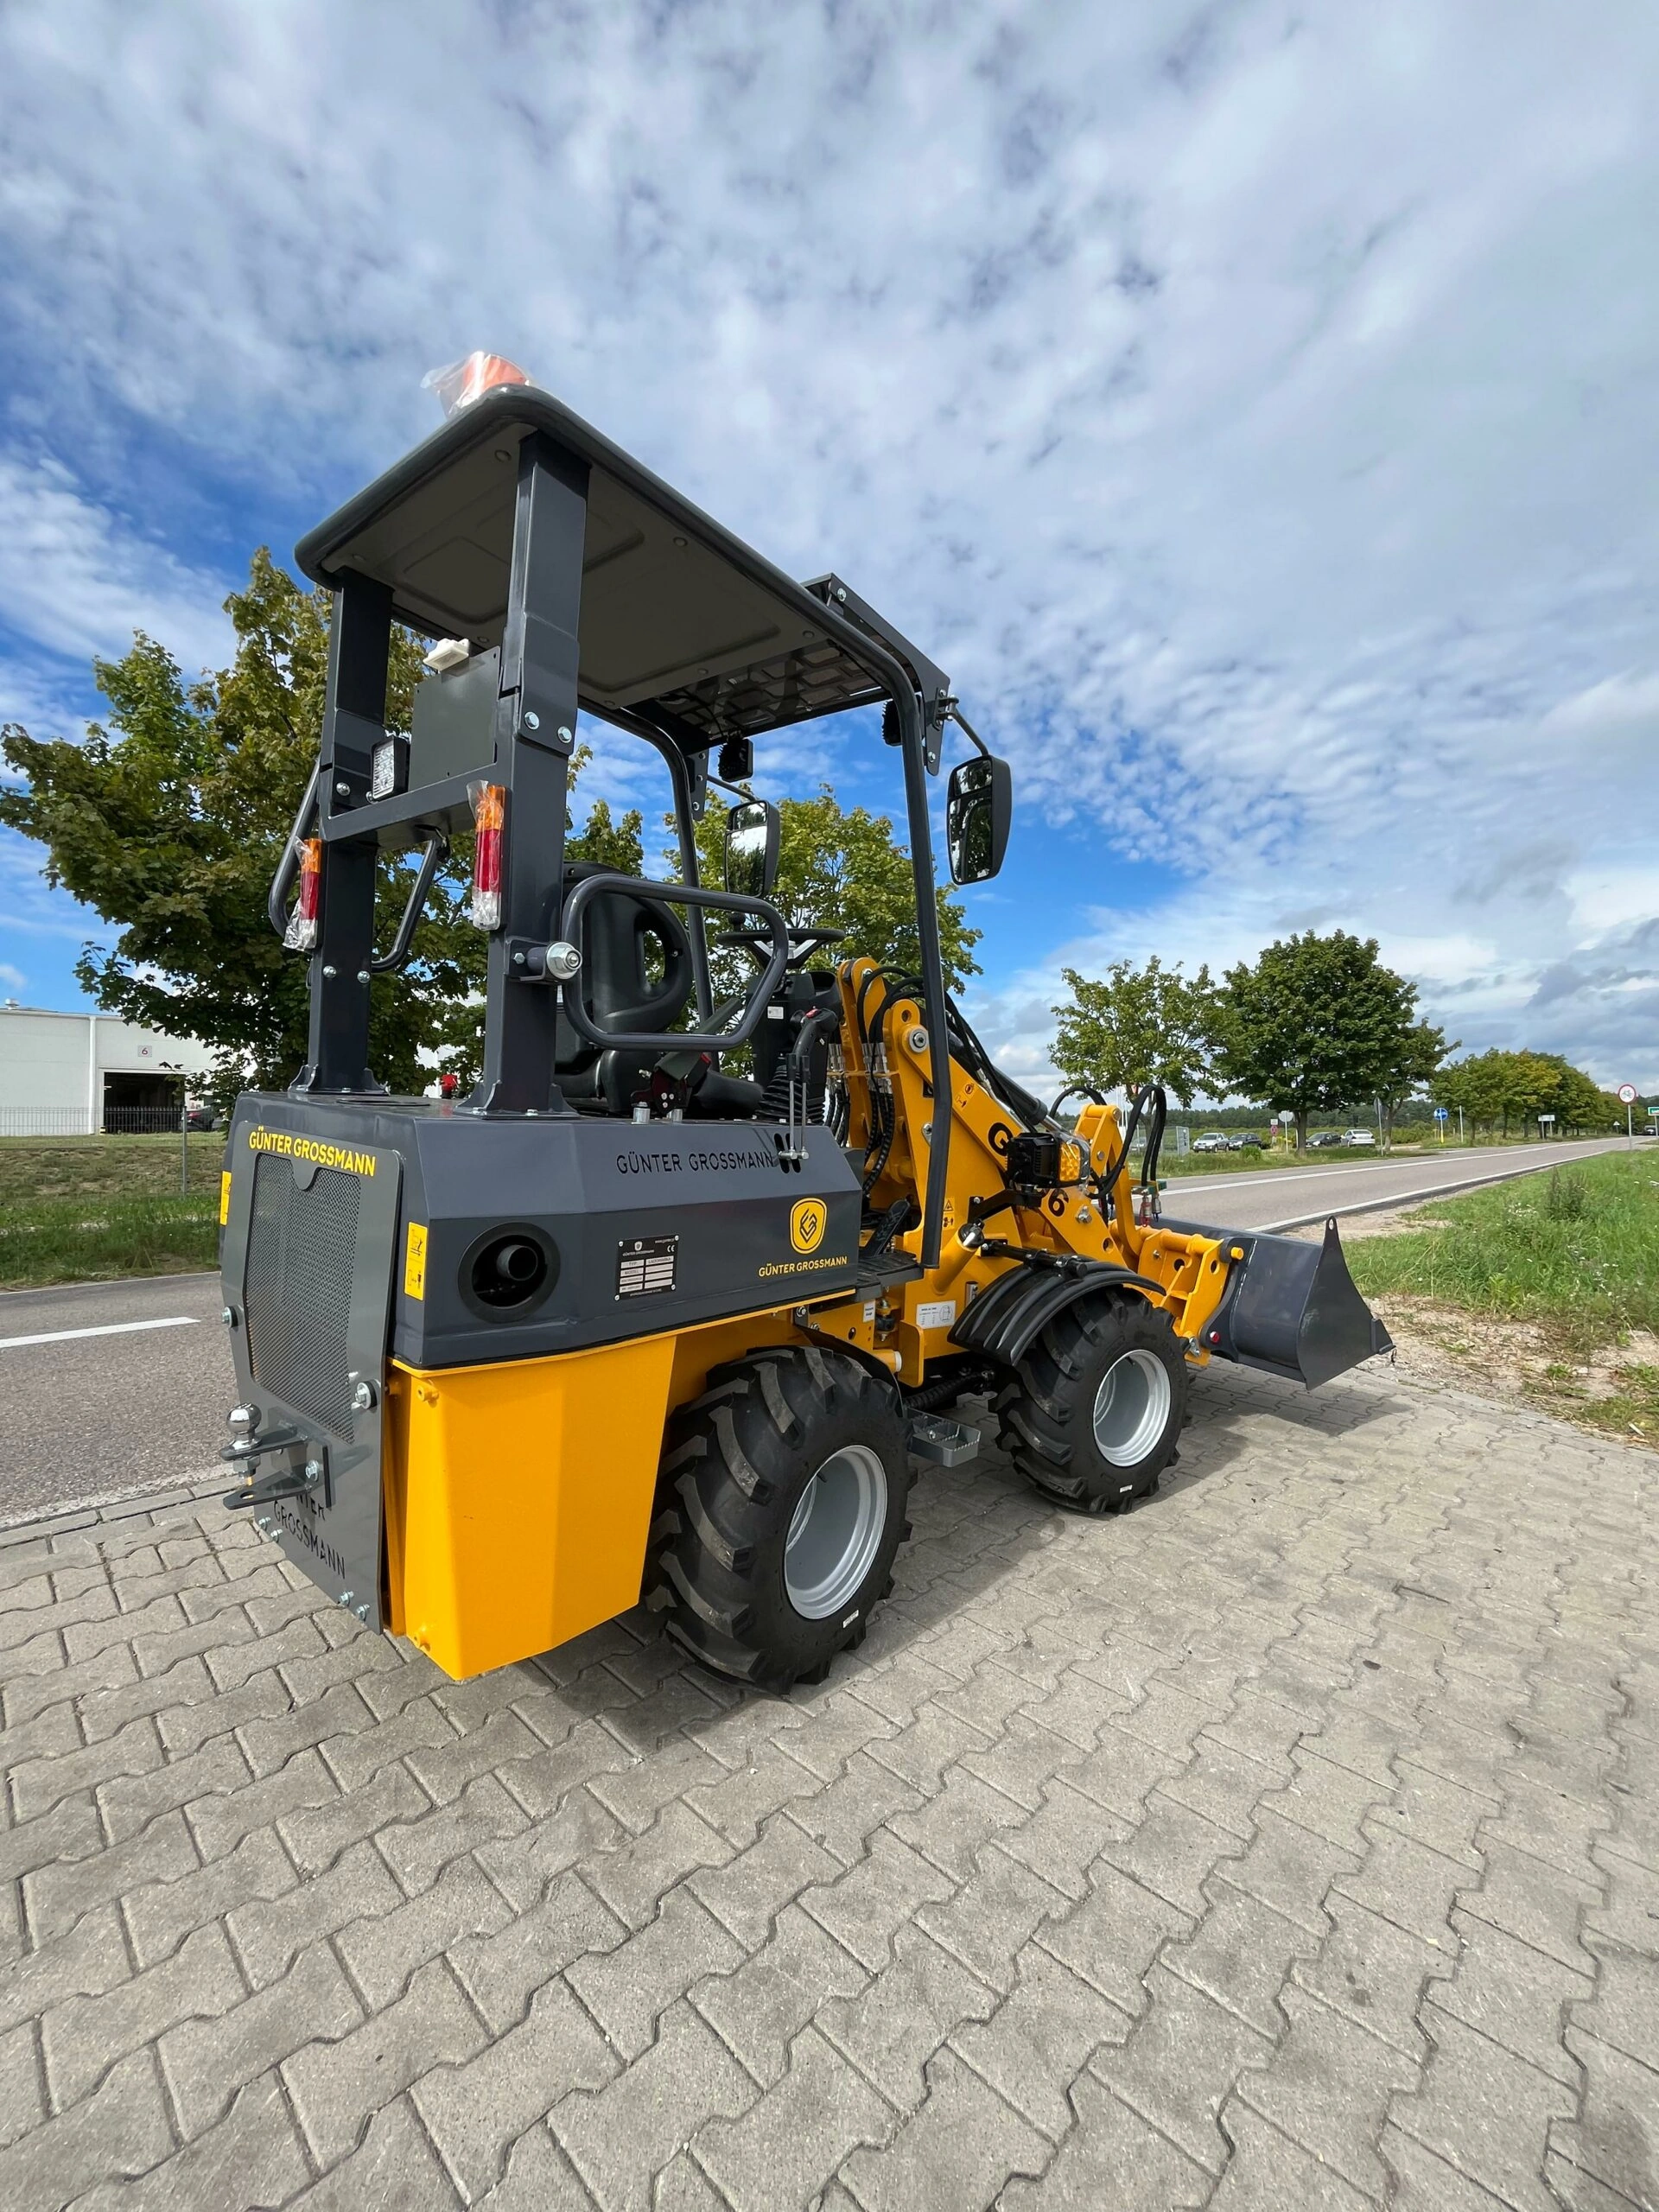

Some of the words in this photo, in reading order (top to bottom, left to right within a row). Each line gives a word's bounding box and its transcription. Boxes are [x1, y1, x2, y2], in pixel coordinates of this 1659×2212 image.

[249, 1126, 292, 1154] GÜNTER
[293, 1138, 376, 1177] GROSSMANN
[616, 1151, 683, 1174] GÜNTER
[689, 1152, 775, 1172] GROSSMANN
[758, 1262, 795, 1277] GÜNTER
[796, 1255, 848, 1272] GROSSMANN
[274, 1500, 345, 1580] GROSSMANN
